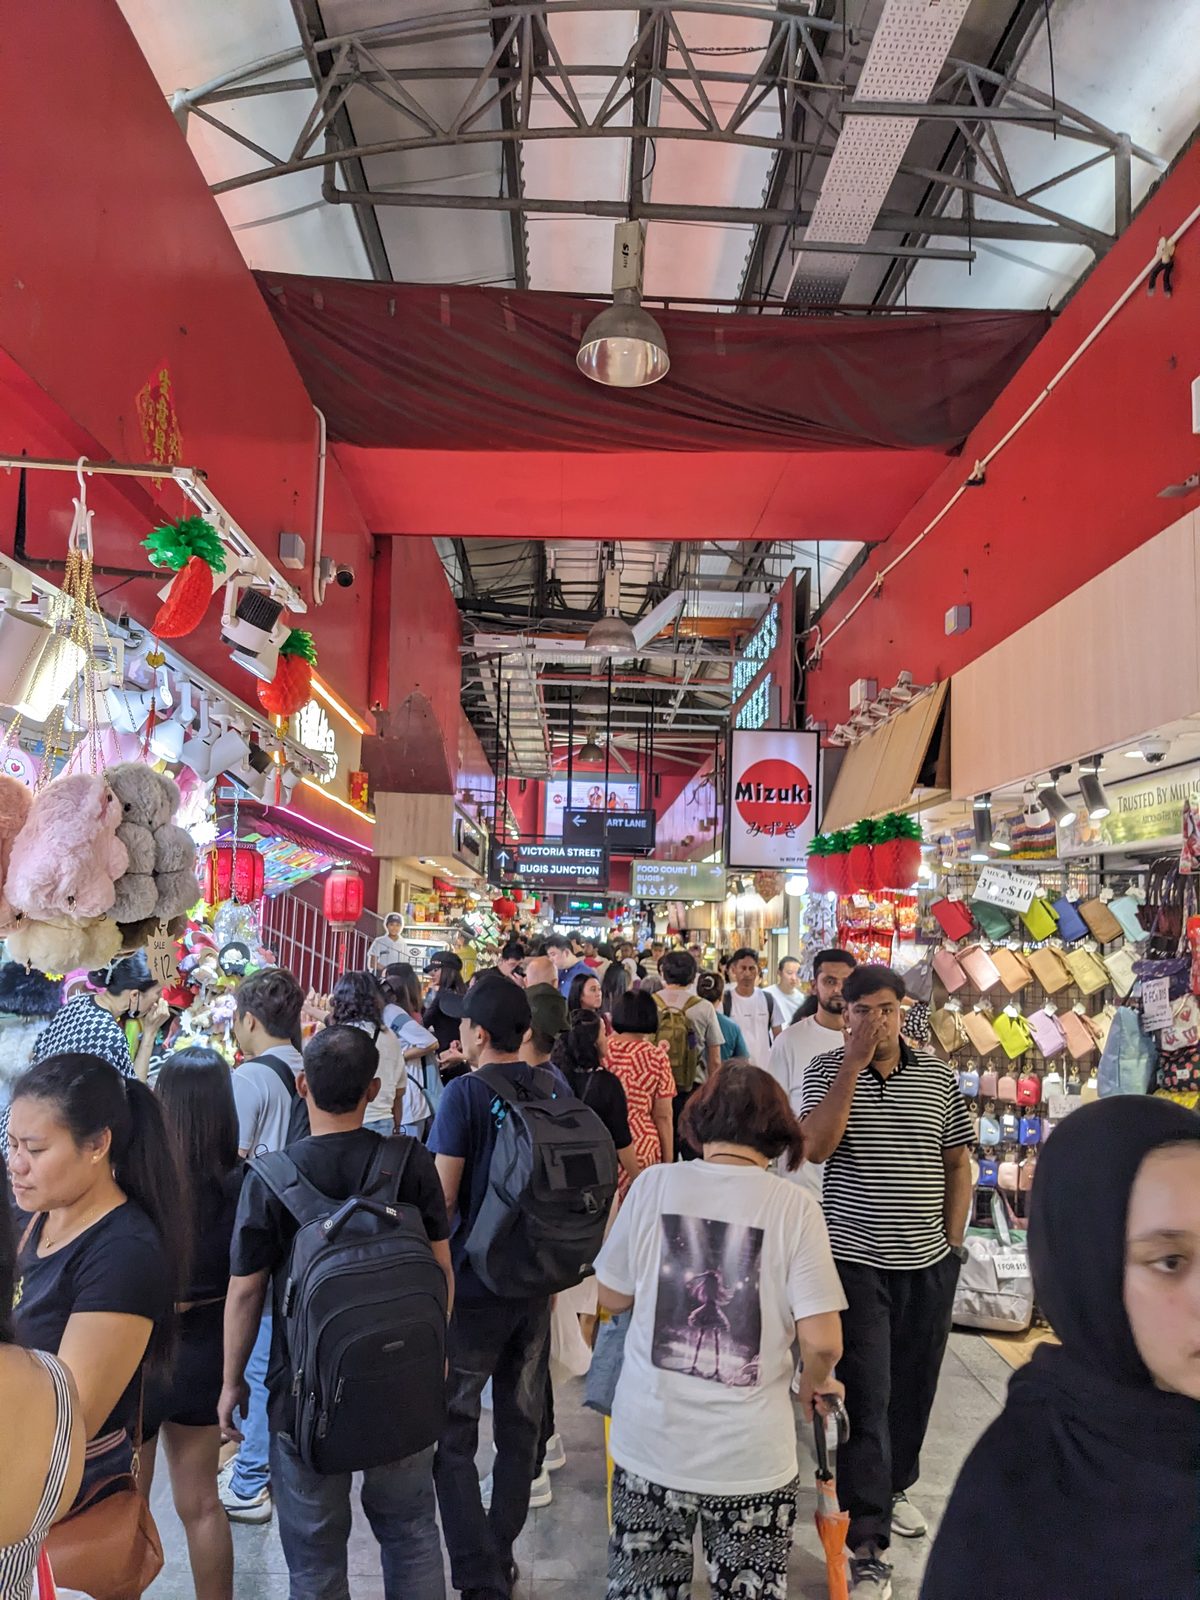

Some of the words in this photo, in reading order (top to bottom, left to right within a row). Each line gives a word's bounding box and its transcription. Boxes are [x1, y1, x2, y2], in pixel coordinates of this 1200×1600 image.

[735, 782, 812, 803] Mizuki
[1117, 792, 1155, 813] TRUSTED
[1157, 787, 1167, 805] BY
[606, 819, 623, 827] ART
[624, 820, 647, 828] LANE
[746, 821, 797, 838] みずき
[520, 846, 565, 856] VICTORIA
[567, 848, 602, 857] STREET
[520, 864, 548, 873] BUGIS
[550, 865, 599, 875] JUNCTION
[637, 865, 659, 873] FOOD
[660, 866, 688, 874] COURT
[153, 941, 165, 950] SALE
